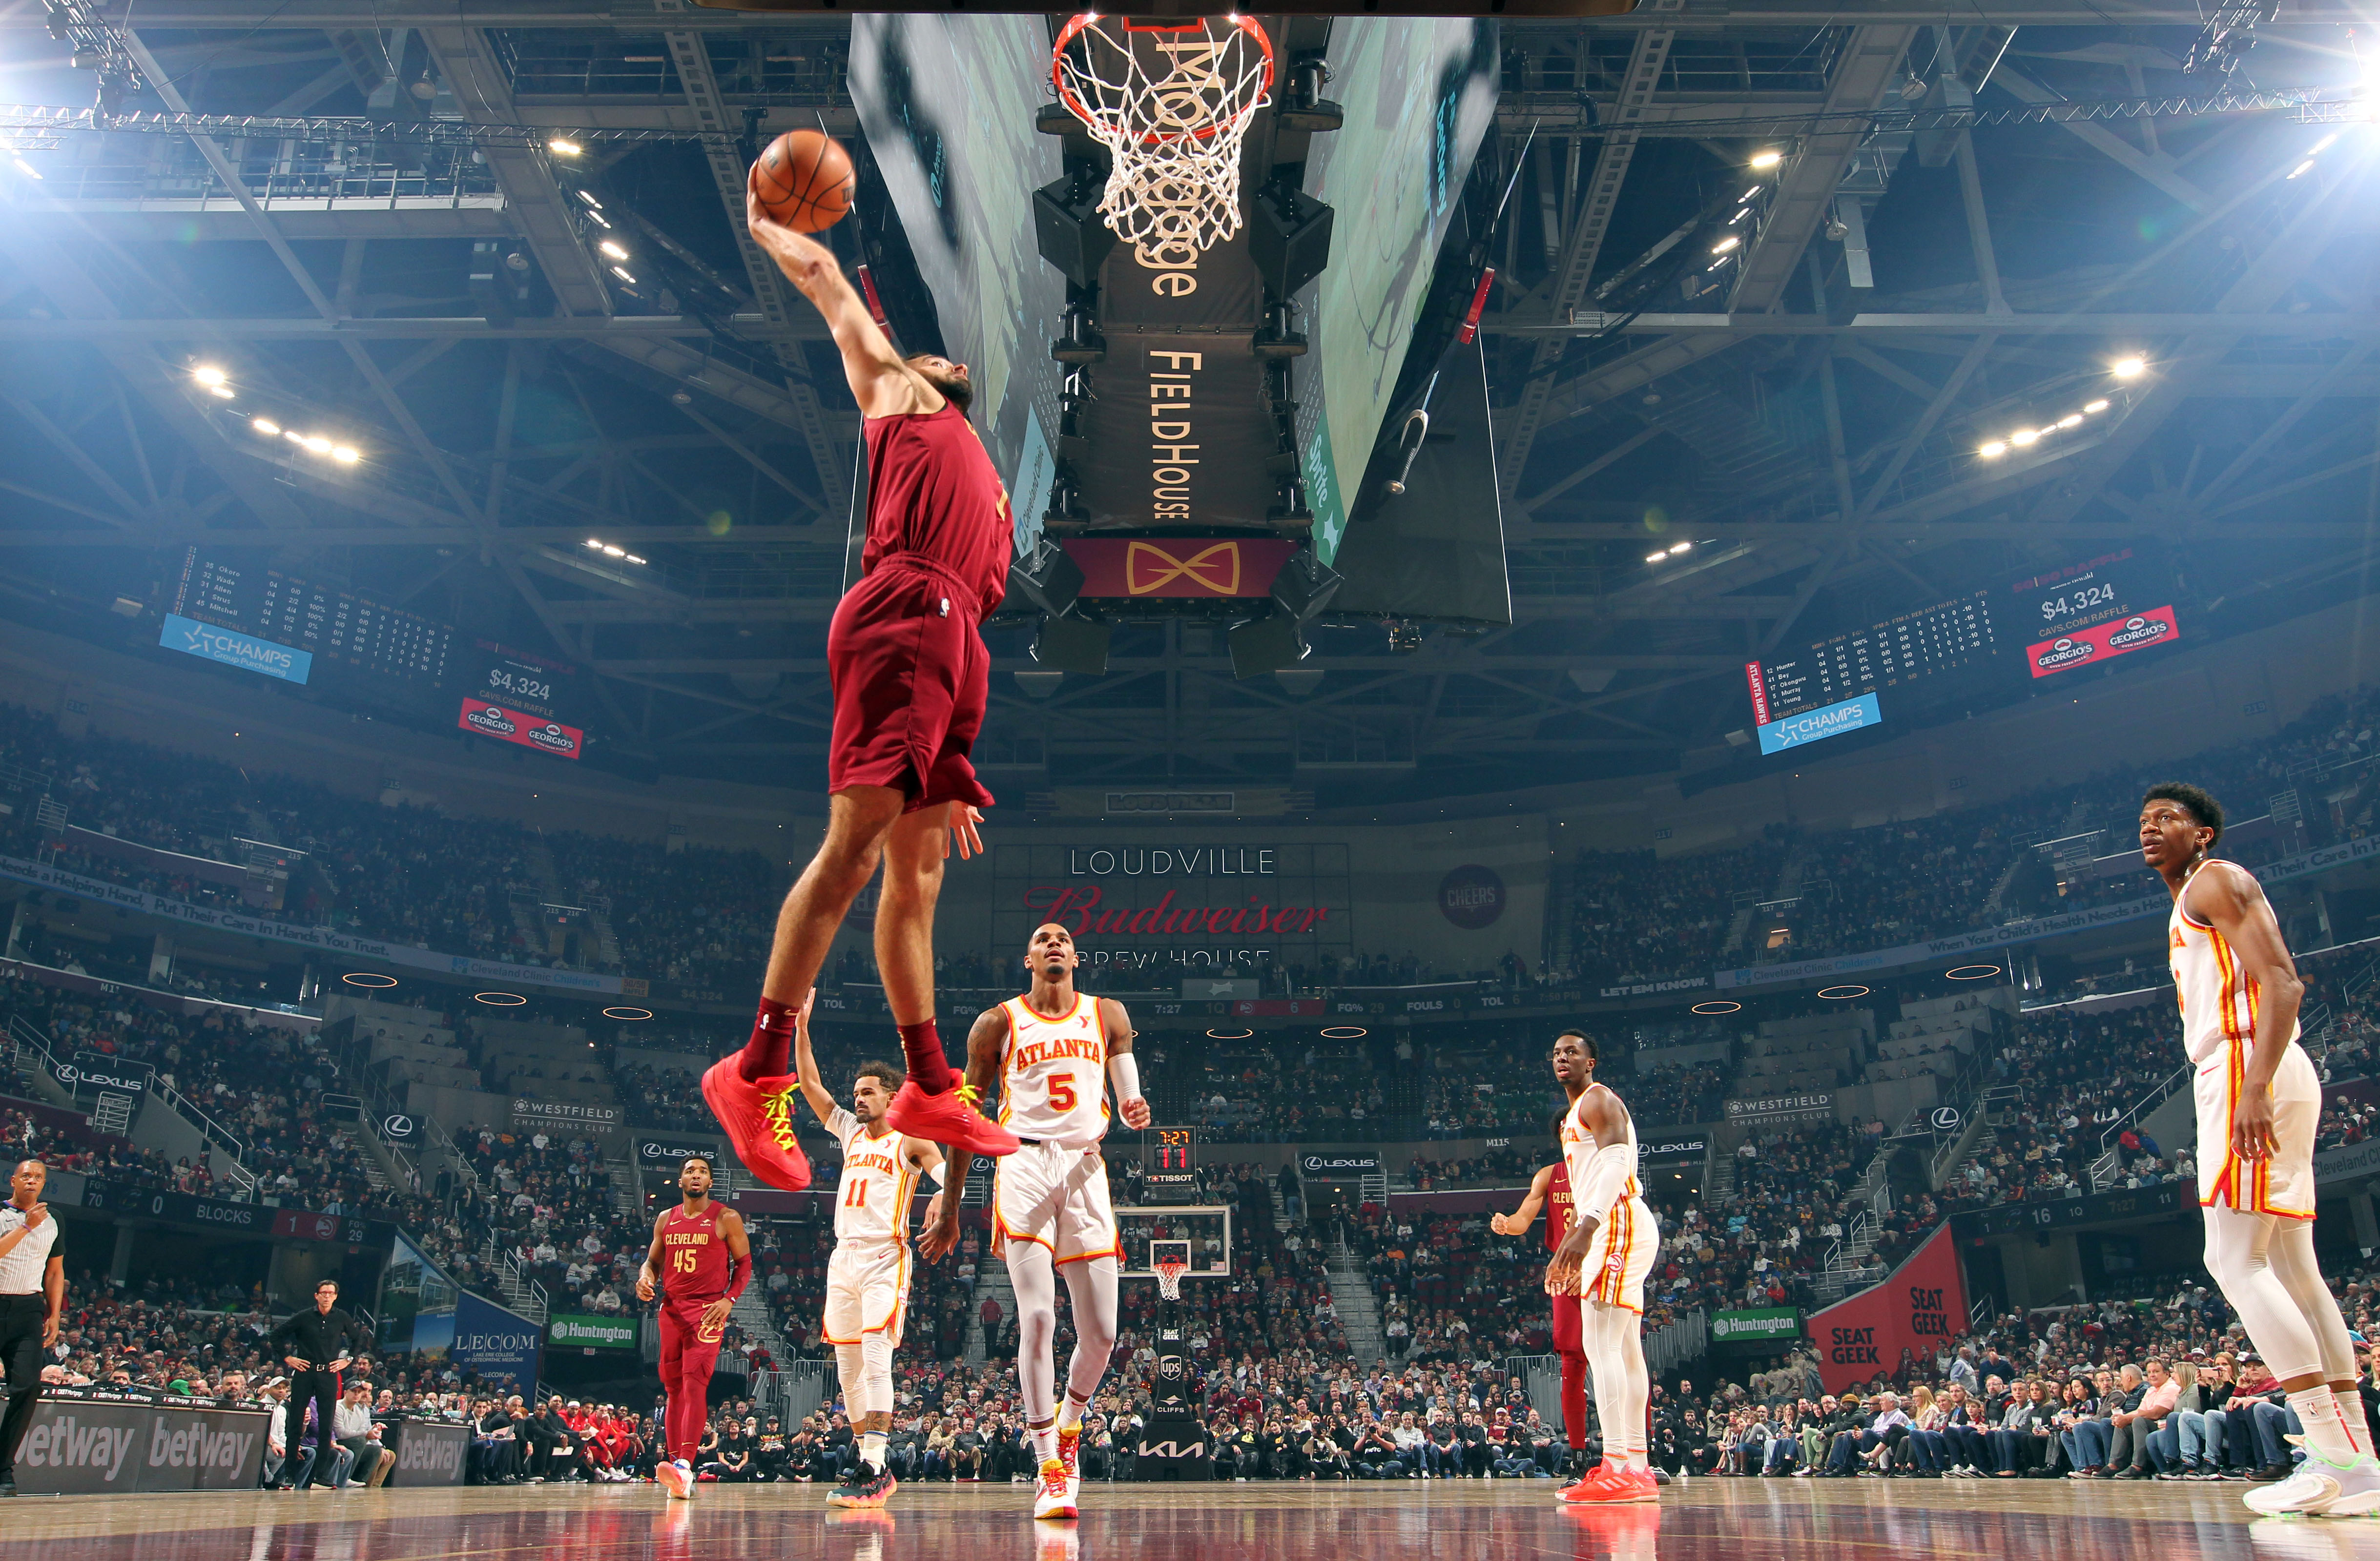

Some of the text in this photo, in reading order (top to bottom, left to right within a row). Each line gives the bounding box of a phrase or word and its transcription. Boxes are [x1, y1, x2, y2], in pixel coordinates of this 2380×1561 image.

[1134, 41, 1227, 297] Motgage
[1150, 350, 1202, 520] FIELDHOUSE
[1309, 434, 1327, 508] Sprite
[1023, 444, 1044, 528] Cleveland Clinic
[216, 575, 235, 586] Wade
[219, 566, 240, 577] Okoro
[212, 594, 231, 604] Strus
[214, 585, 232, 595] Allen
[209, 603, 238, 616] Mitchell
[2041, 583, 2114, 621] $4,324
[2110, 623, 2167, 646] GEORGIO'S
[215, 636, 292, 668] CHAMPS
[2038, 644, 2093, 667] GEORGIO'S
[213, 650, 287, 677] Group Purchasing
[1776, 661, 1796, 672] Hunter
[489, 668, 550, 700] $4,324
[1778, 672, 1789, 680] Bey
[1780, 676, 1806, 688] Okongwu
[1749, 664, 1767, 724] ATLANTA HAWKS
[1781, 686, 1801, 697] Murray
[1782, 695, 1801, 705] Young
[1774, 702, 1818, 719] TEAM TOTALS
[1799, 704, 1863, 733] CHAMPS
[468, 713, 515, 733] GEORGIO'S
[1802, 719, 1863, 741] Group Purchasing
[529, 730, 574, 748] GEORGIO'S
[1072, 848, 1274, 875] LOUDVILLE
[2268, 843, 2368, 877] Their Care In
[1447, 886, 1496, 907] CHEERS
[41, 871, 50, 880] a
[54, 872, 104, 898] Helping
[108, 886, 145, 906] Hand,
[155, 899, 179, 914] Put
[182, 905, 217, 924] Their
[221, 915, 254, 931] Care
[259, 921, 272, 934] In
[276, 925, 319, 943] Hands
[324, 933, 348, 949] You
[353, 939, 390, 956] Trust.
[1024, 885, 1328, 938] Budweiser
[1928, 937, 1964, 953] When
[1966, 932, 1993, 946] Your
[1997, 923, 2040, 941] Child's
[2043, 913, 2086, 931] Health
[2088, 906, 2130, 923] Needs
[2133, 905, 2141, 914] a
[471, 964, 600, 987] Cleveland Clinic Children's
[1754, 955, 1883, 980] Cleveland Clinic Children's
[624, 979, 646, 988] 50/50
[1600, 978, 1708, 997] LET EM KNOW.
[823, 999, 846, 1009] TOL
[953, 1006, 979, 1015] FG%
[1155, 1004, 1182, 1014] 7:27
[1205, 1003, 1225, 1014] 1Q
[1290, 1002, 1299, 1013] 6
[1338, 1003, 1363, 1012] FG%
[1369, 1003, 1385, 1014] 29
[1407, 1000, 1444, 1011] FOULS
[1481, 996, 1504, 1006] TOL
[1017, 1039, 1100, 1072] ATLANTA
[80, 1071, 142, 1091] LEXUS
[1047, 1073, 1077, 1113] 5
[1745, 1094, 1829, 1110] WESTFIELD
[532, 1103, 614, 1119] WESTFIELD
[1733, 1111, 1830, 1127] CHAMPIONS CLUB
[514, 1118, 613, 1133] CHAMPIONS CLUB
[1159, 1130, 1189, 1145] 7:27
[1487, 1138, 1510, 1147] M115
[1652, 1142, 1703, 1153] LEXUS
[844, 1153, 893, 1175] ATLANTA
[1163, 1147, 1186, 1169] 11
[1324, 1159, 1375, 1168] LEXUS
[89, 1193, 103, 1207] 70
[845, 1179, 869, 1208] 11
[2158, 1193, 2172, 1204] 11
[152, 1195, 164, 1214] 0
[2070, 1208, 2083, 1218] 1Q
[2108, 1198, 2136, 1212] 7:27
[197, 1205, 251, 1224] BLOCKS
[2031, 1209, 2051, 1224] 16
[290, 1216, 296, 1232] 1
[349, 1230, 363, 1242] 29
[665, 1233, 708, 1246] CLEVELAND
[674, 1249, 697, 1273] 45
[1910, 1287, 1943, 1311] SEAT
[569, 1322, 632, 1342] Huntington
[1730, 1317, 1794, 1334] Huntington
[1912, 1313, 1951, 1337] GEEK
[1832, 1327, 1875, 1345] SEAT
[1832, 1346, 1882, 1365] GEEK
[1162, 1363, 1180, 1376] ups
[149, 1417, 253, 1480] betway
[398, 1425, 465, 1481] betway
